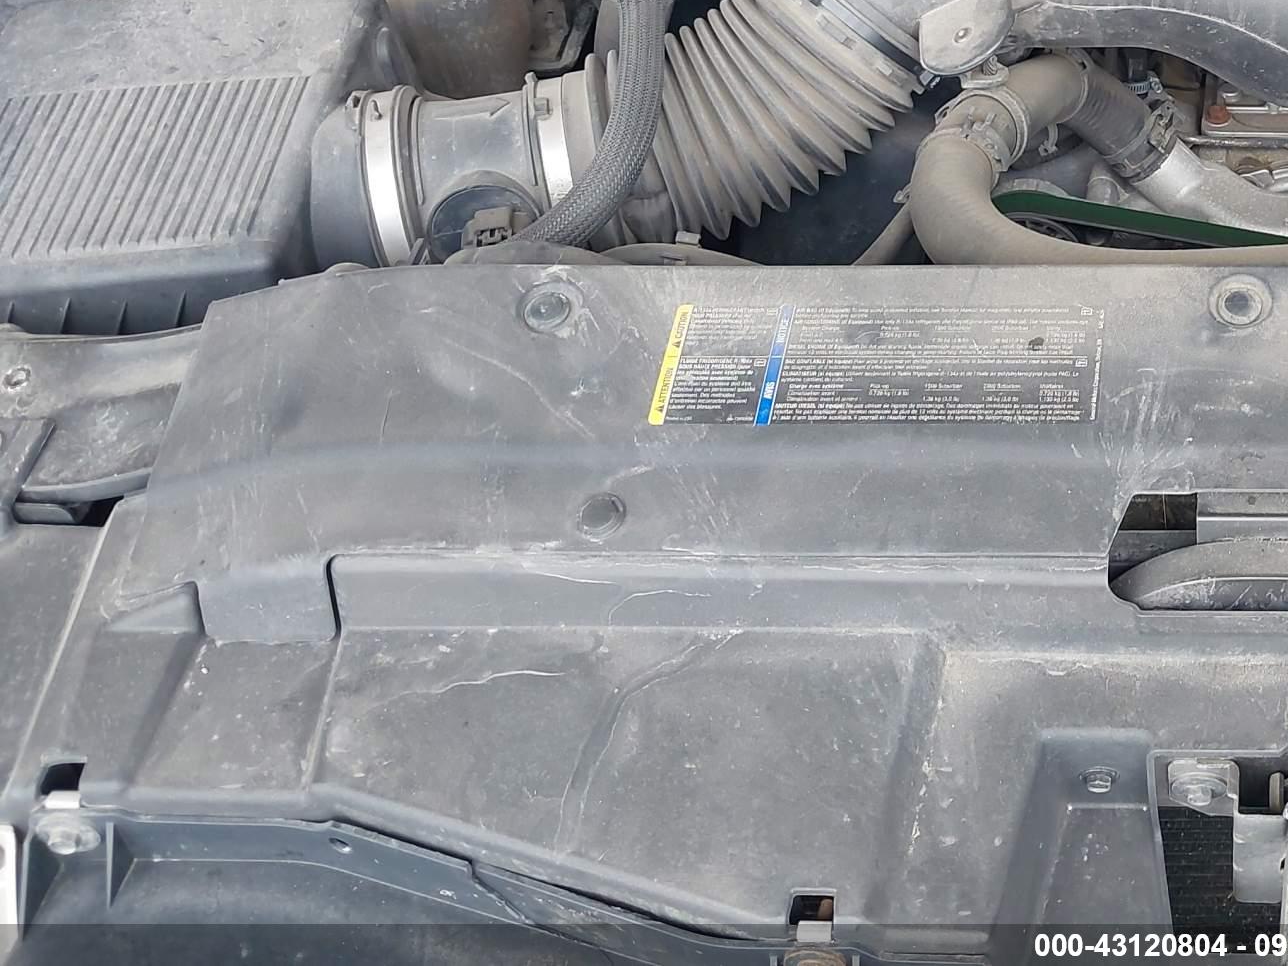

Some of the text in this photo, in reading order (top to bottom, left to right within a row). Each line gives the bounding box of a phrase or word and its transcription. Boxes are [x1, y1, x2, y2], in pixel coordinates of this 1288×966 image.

[676, 312, 690, 338] CAUTION
[776, 318, 790, 343] NOTICE
[658, 367, 674, 406] ATTENTION
[763, 381, 776, 399] AVIS
